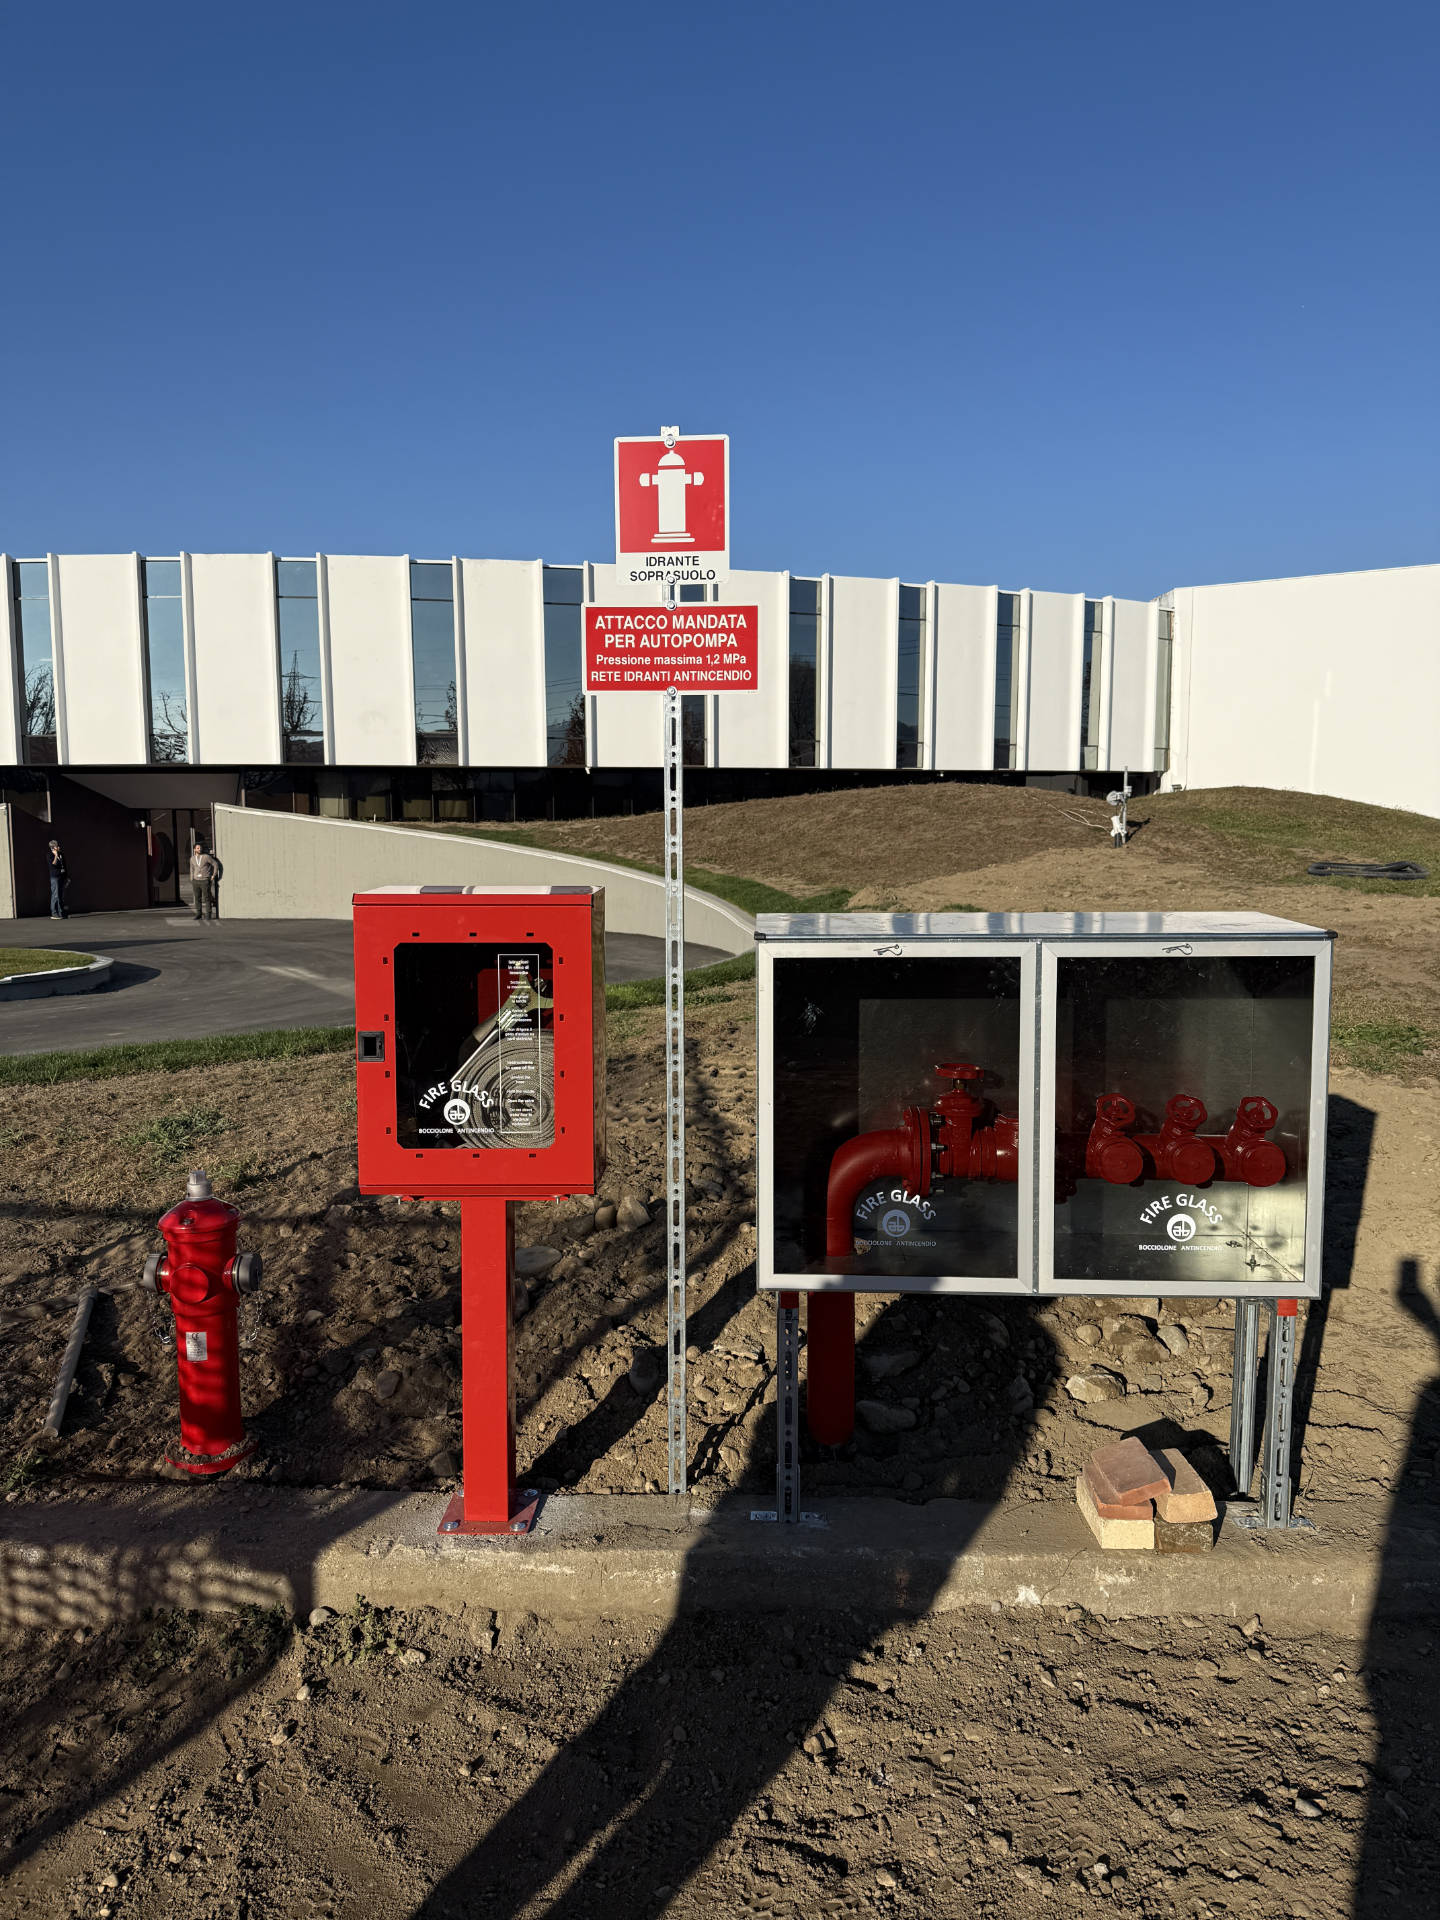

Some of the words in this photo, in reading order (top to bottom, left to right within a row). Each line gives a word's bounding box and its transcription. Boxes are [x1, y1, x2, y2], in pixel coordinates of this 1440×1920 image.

[645, 555, 700, 567] IDRANTE
[595, 615, 668, 630] ATTACCO
[672, 614, 747, 629] MANDATA
[604, 634, 636, 648] PER
[639, 633, 738, 648] AUTOPOMPA
[596, 654, 651, 665] Pressione
[653, 654, 702, 665] massima
[705, 654, 720, 667] 1,2
[723, 653, 747, 664] MPa
[591, 671, 621, 682] RETE
[624, 671, 671, 682] IDRANTI
[673, 670, 752, 681] ANTINCENDIO
[418, 1081, 449, 1109] FIRE
[451, 1080, 494, 1108] GLASS
[856, 1191, 888, 1220] FIRE
[890, 1189, 937, 1220] GLASS
[1139, 1195, 1173, 1225] FIRE
[1175, 1193, 1223, 1225] GLASS
